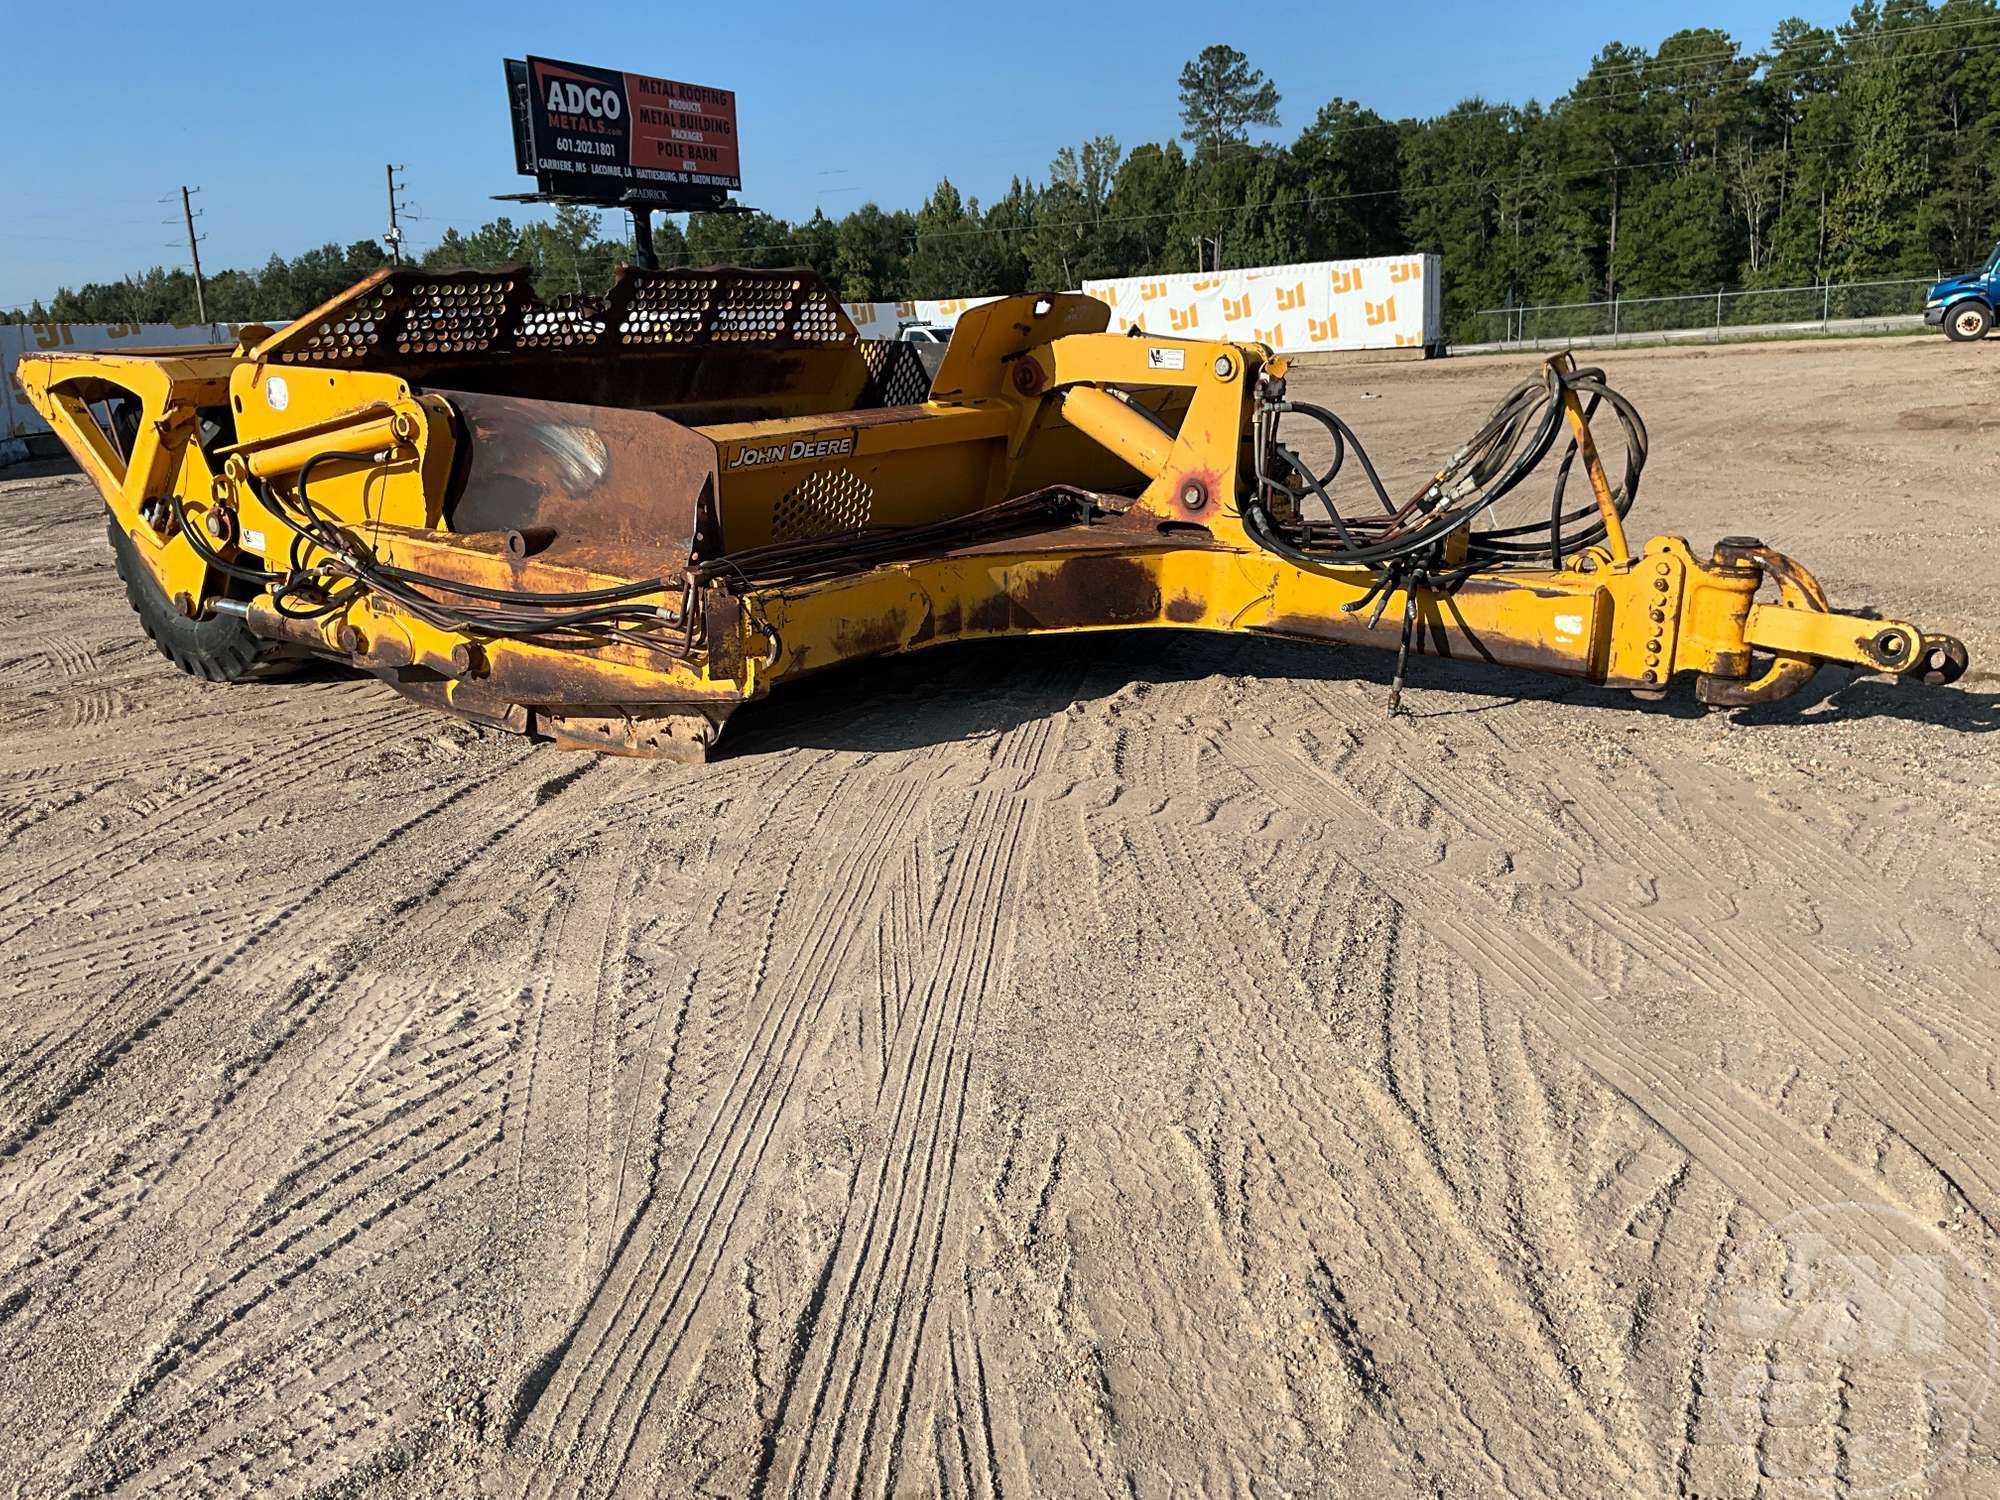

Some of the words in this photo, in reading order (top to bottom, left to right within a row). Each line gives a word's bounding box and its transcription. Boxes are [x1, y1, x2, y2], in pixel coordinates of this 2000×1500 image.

[547, 81, 621, 120] ADCO
[640, 79, 676, 98] METAL
[678, 84, 727, 106] ROOFING
[640, 109, 676, 127] METAL
[680, 114, 731, 135] BUILDING
[671, 128, 704, 142] PACKAGES
[556, 137, 616, 157] 601.202.1801
[657, 141, 685, 159] POLE
[688, 145, 718, 162] BARN
[730, 445, 787, 468] JOHN
[788, 437, 853, 460] DEERE
